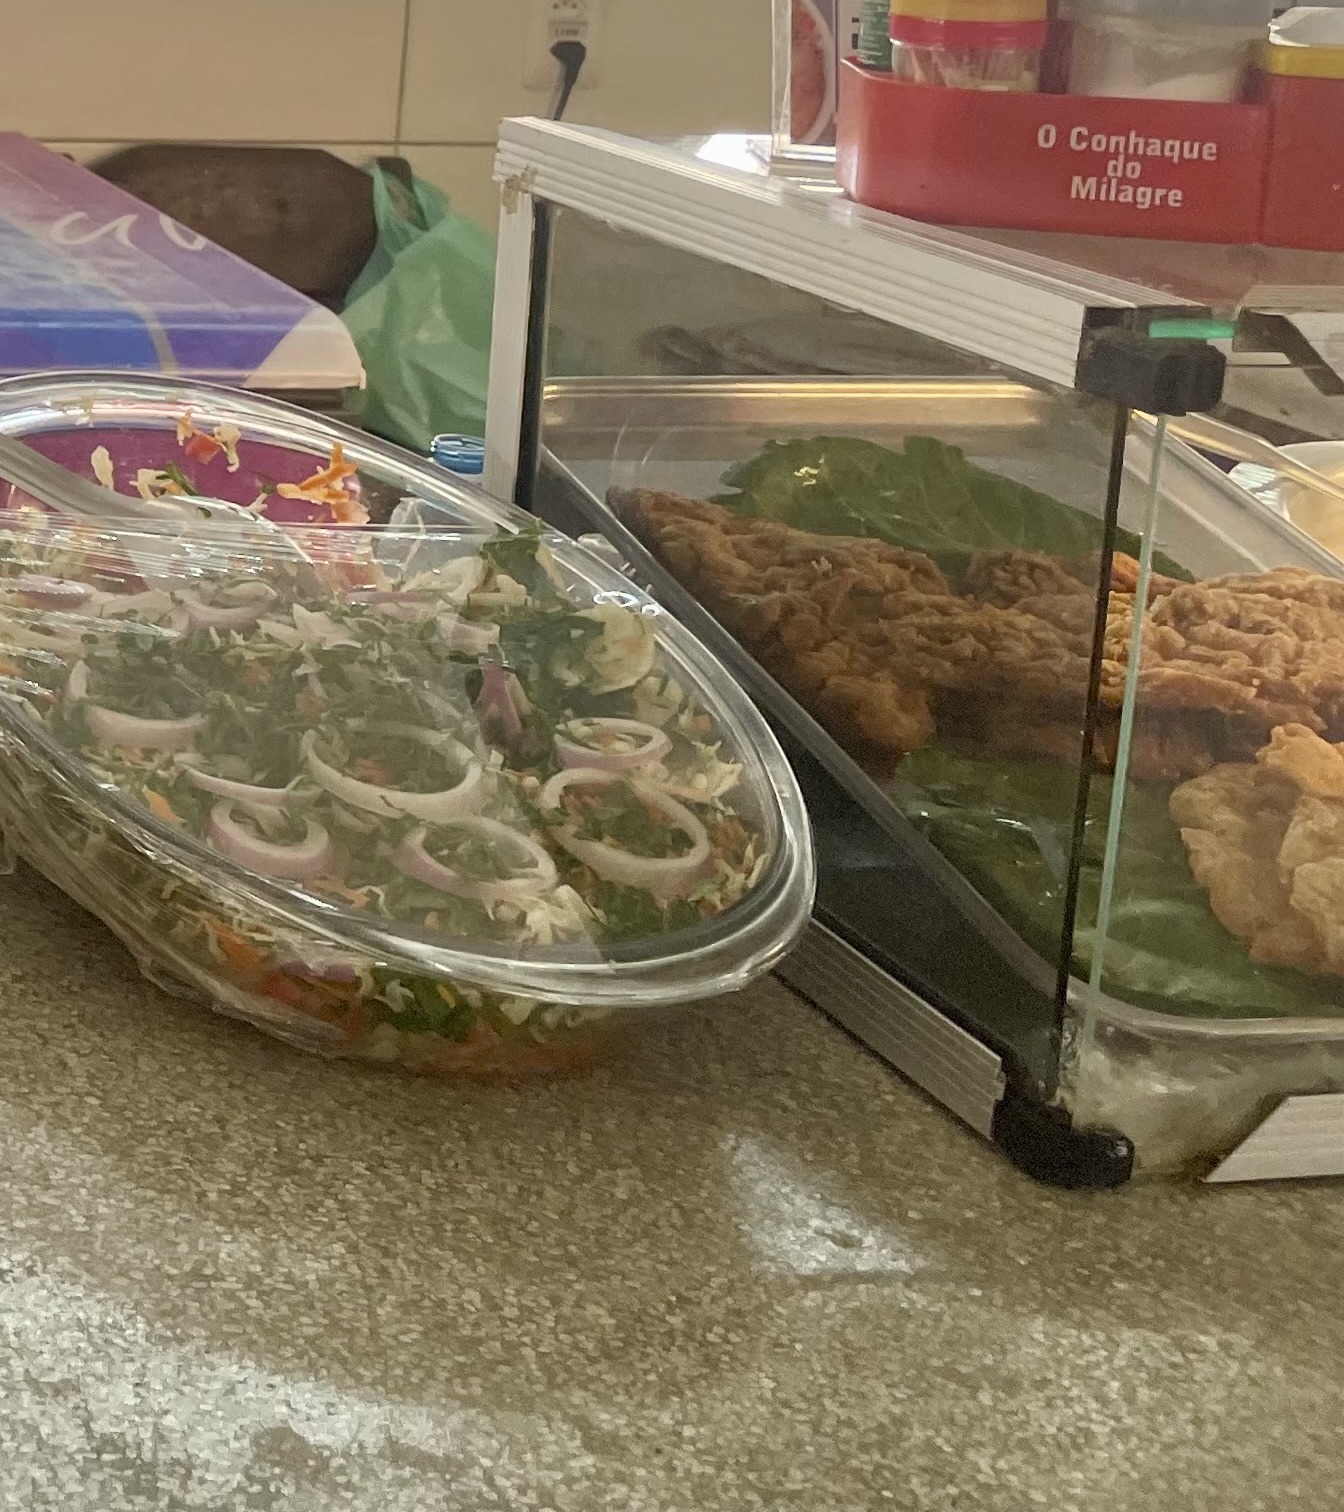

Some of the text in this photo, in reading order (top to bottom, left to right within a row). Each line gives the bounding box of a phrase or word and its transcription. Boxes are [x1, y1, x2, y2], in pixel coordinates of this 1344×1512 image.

[1037, 123, 1218, 165] O Conhaque
[1106, 154, 1143, 180] do
[1070, 175, 1184, 210] Milagre
